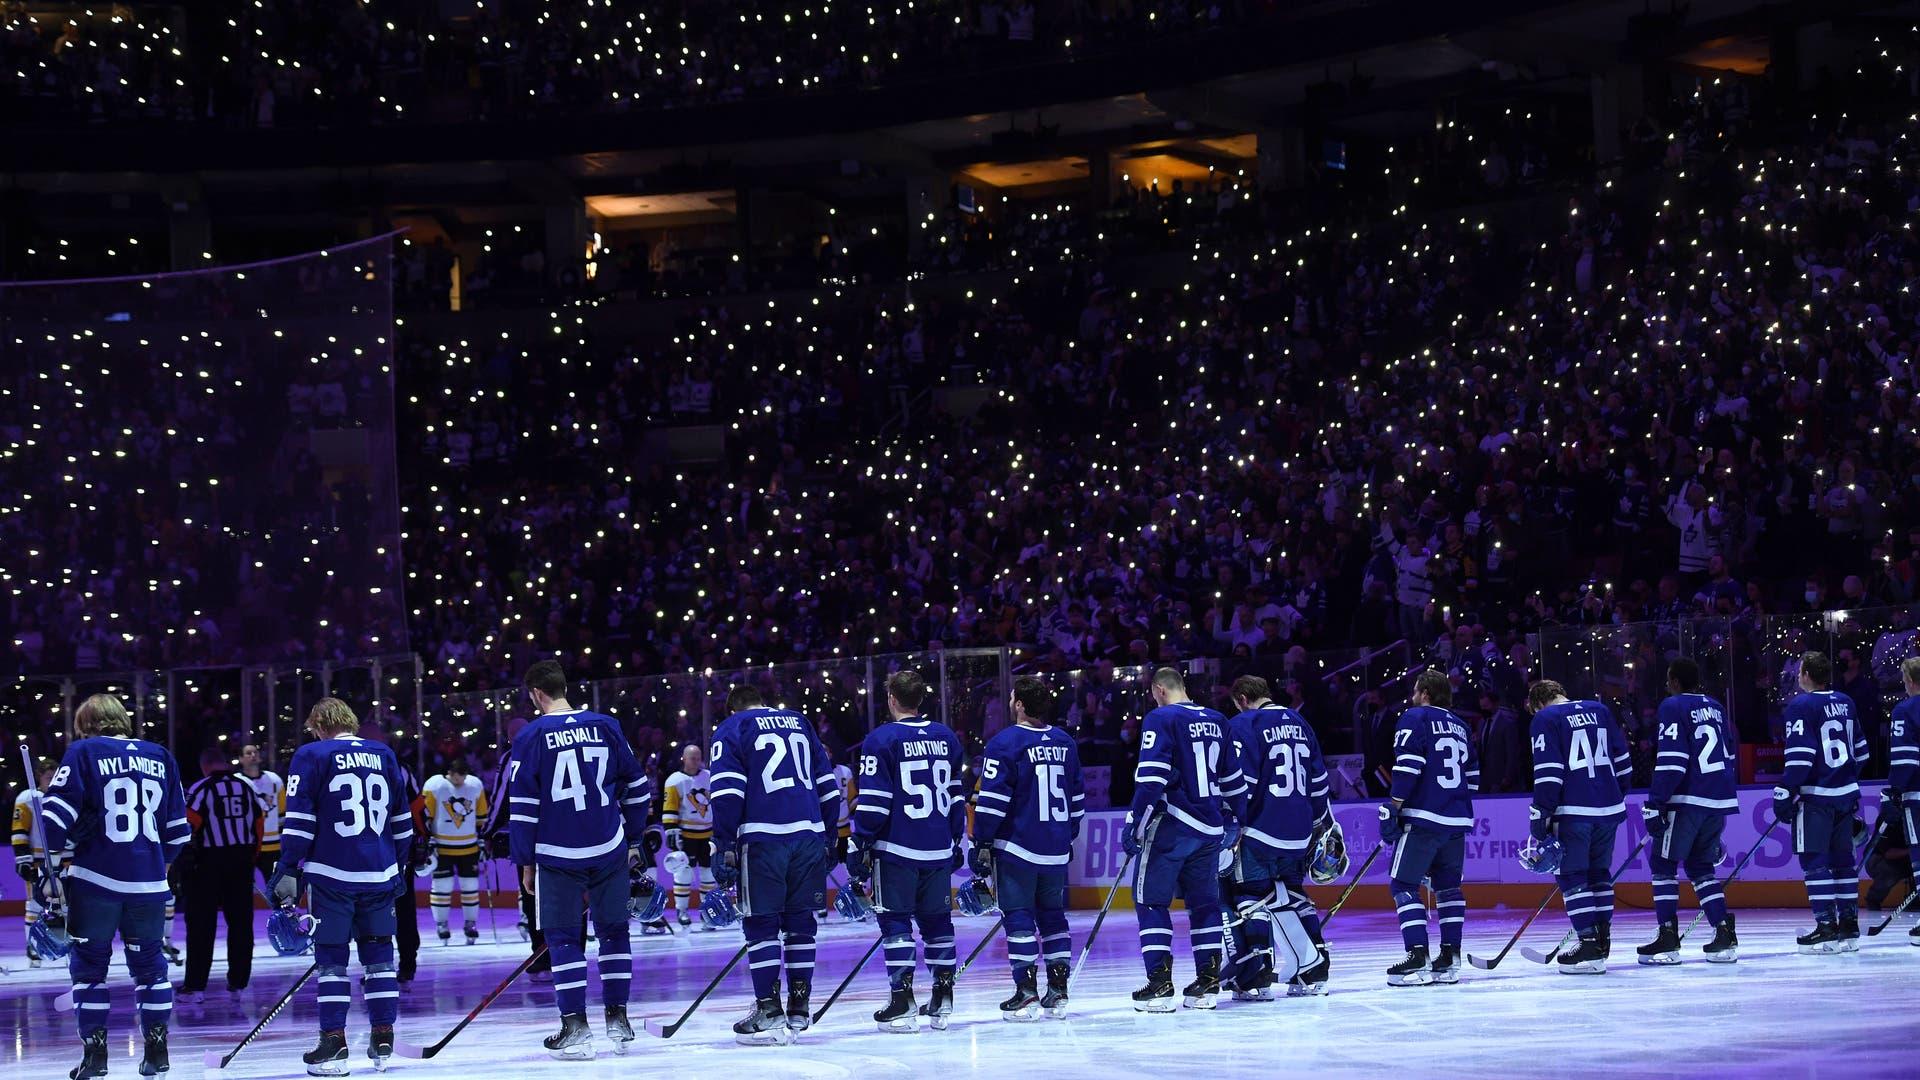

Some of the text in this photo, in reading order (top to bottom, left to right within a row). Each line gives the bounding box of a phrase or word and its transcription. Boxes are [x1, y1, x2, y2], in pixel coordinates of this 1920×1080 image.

[755, 716, 802, 730] RITCHIE
[1566, 712, 1598, 728] RIELLY
[1890, 720, 1905, 737] 5
[545, 727, 603, 750] ENGVALL
[902, 740, 949, 758] BUNTING
[335, 752, 382, 771] SANDIN
[709, 740, 723, 762] 0
[1568, 727, 1616, 778] 44
[97, 755, 166, 780] NYLANDER
[509, 760, 521, 783] 7
[754, 732, 813, 794] 20
[1268, 742, 1311, 798] 36
[286, 774, 300, 797] 8
[551, 746, 610, 812] 47
[899, 759, 952, 820] 58
[1035, 764, 1069, 822] 15
[103, 776, 164, 844] 88
[222, 796, 243, 817] 16
[328, 772, 390, 838] 38
